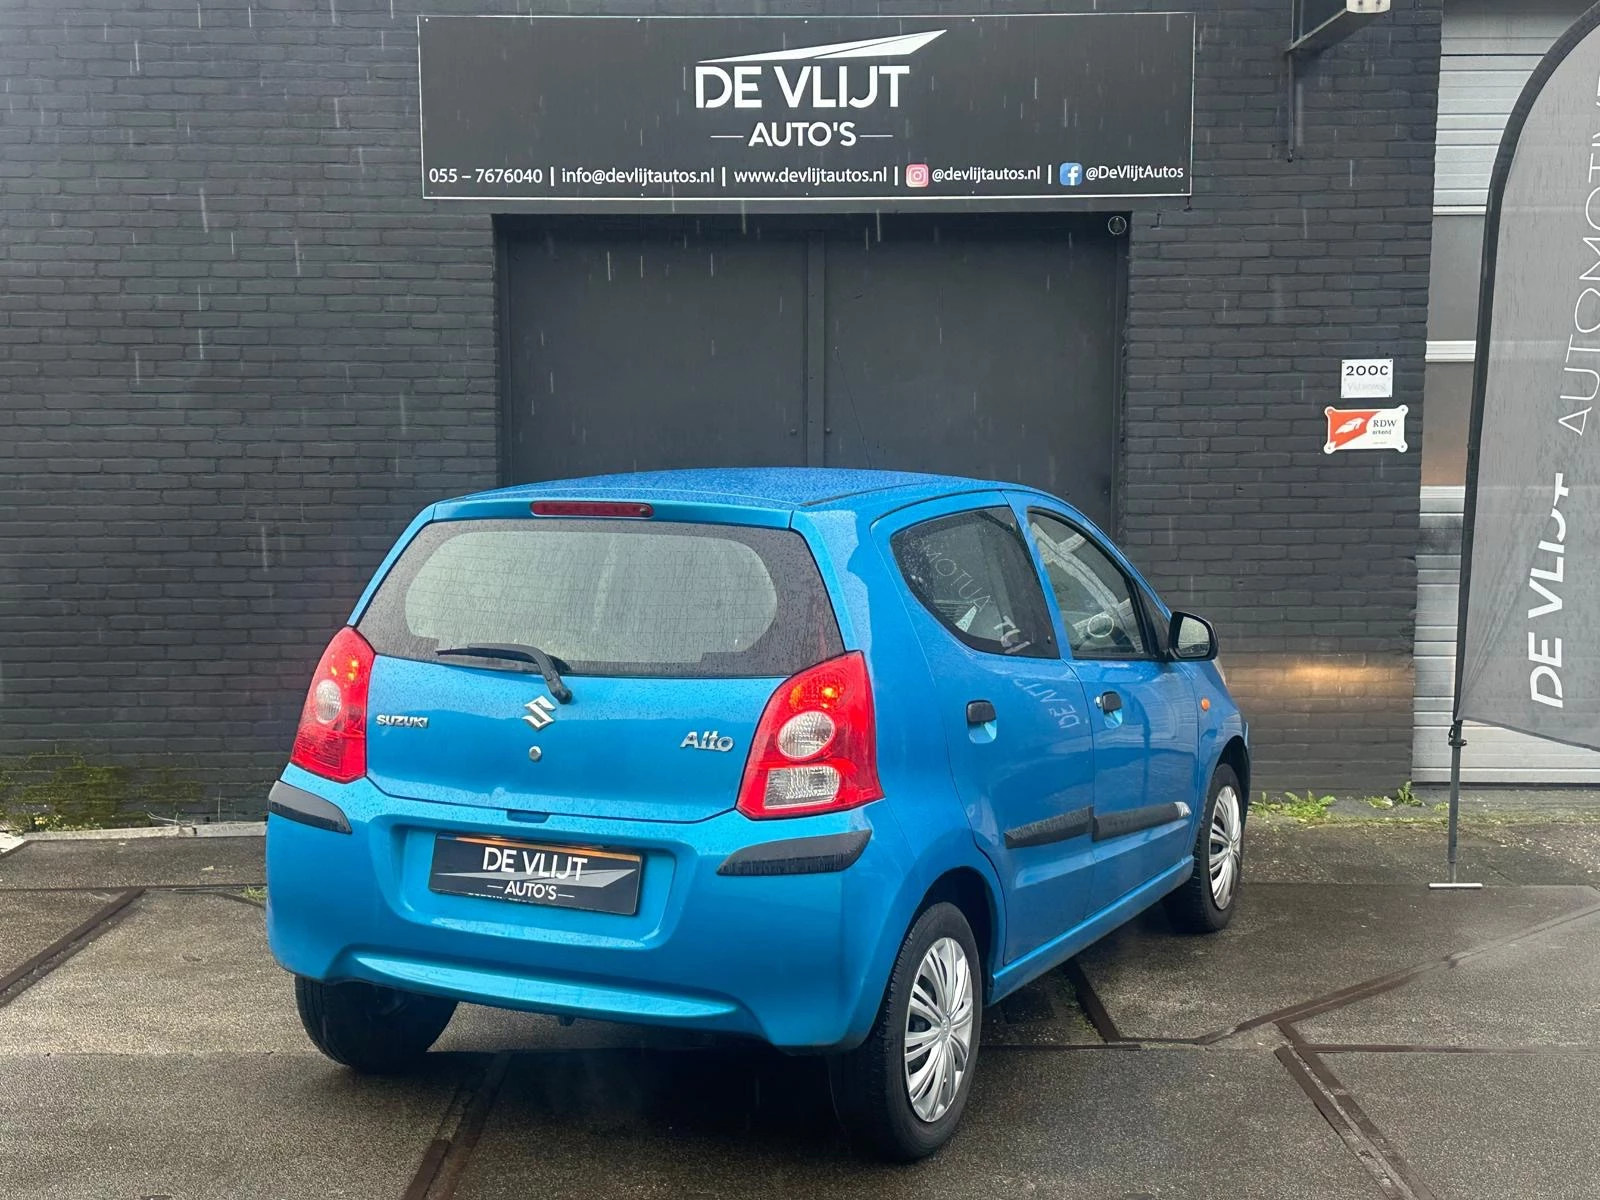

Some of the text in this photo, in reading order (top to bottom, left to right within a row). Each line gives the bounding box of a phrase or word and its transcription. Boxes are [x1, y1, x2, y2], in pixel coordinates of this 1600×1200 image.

[695, 65, 911, 109] DE VLIJT
[748, 121, 857, 147] AUTO'S
[428, 167, 458, 184] 055
[475, 167, 543, 184] 7676040
[561, 165, 715, 188] info@devlijtautos.nl
[733, 165, 887, 187] www.devlijtautos.nl
[931, 164, 1041, 185] @devlijtautos.nl
[1085, 164, 1184, 184] @DeVlijtAutos
[1373, 419, 1398, 428] RDW
[1527, 631, 1564, 709] DE
[376, 714, 429, 729] SUZUKI
[680, 730, 735, 753] Alto
[482, 847, 588, 882] DE VLIJT
[504, 880, 557, 900] AUTO'S
